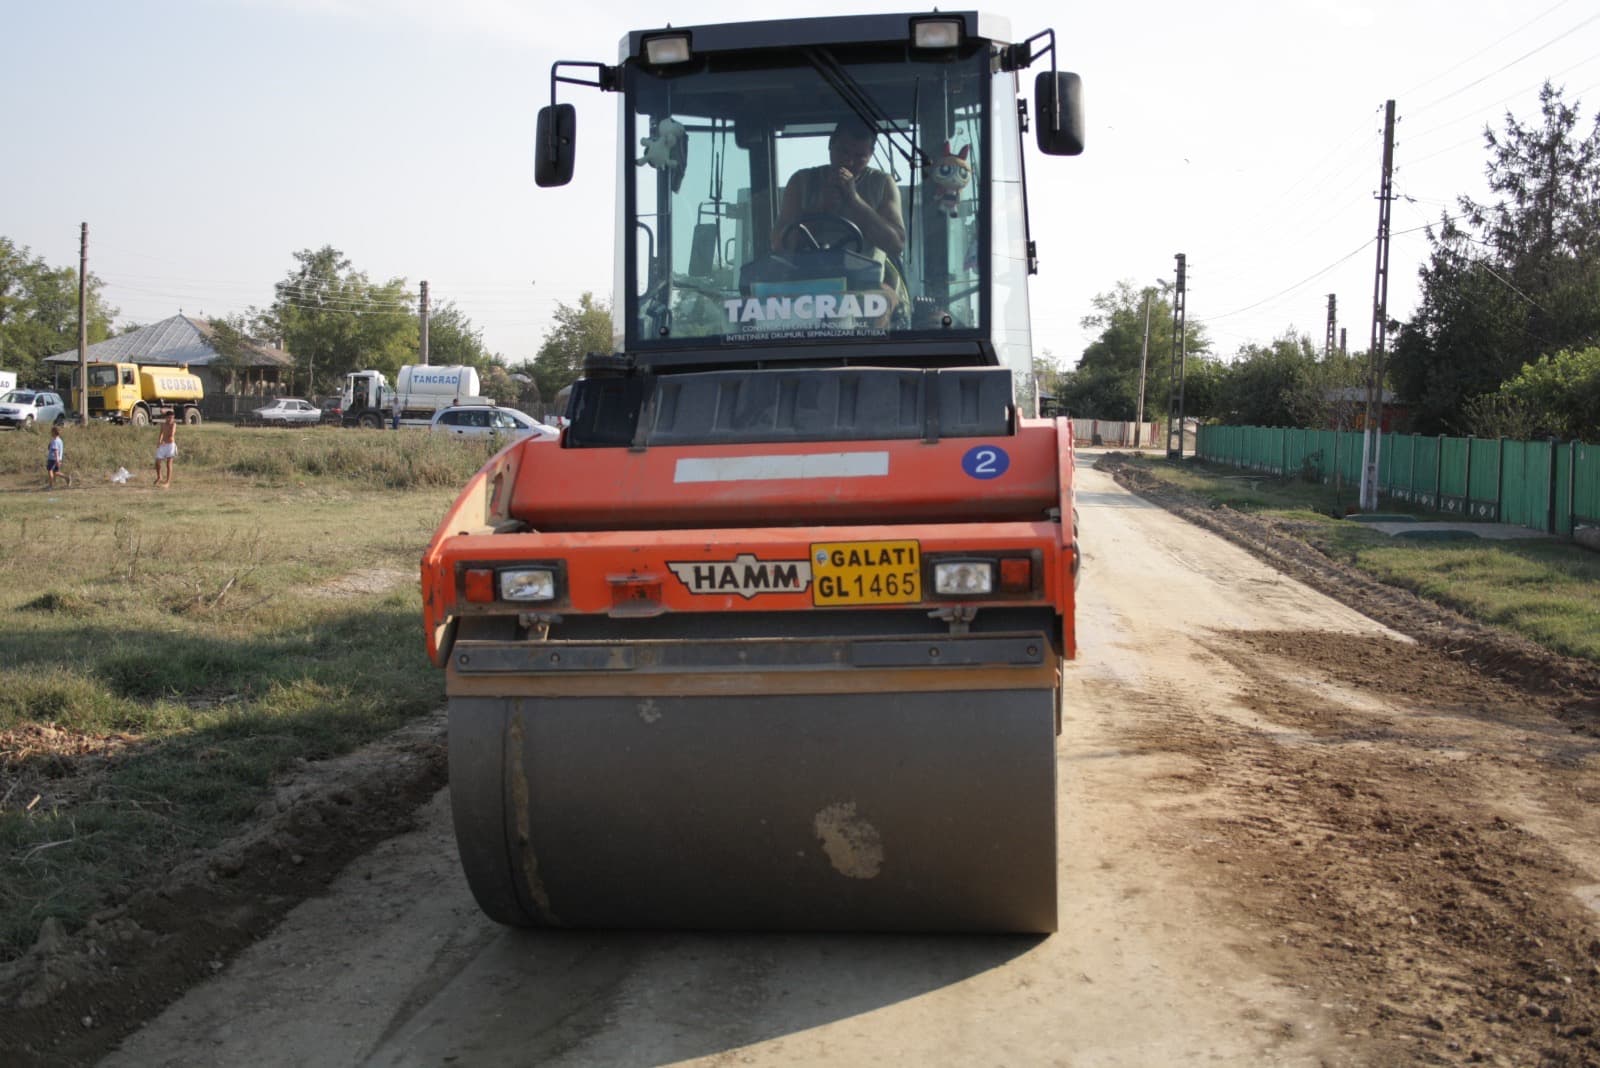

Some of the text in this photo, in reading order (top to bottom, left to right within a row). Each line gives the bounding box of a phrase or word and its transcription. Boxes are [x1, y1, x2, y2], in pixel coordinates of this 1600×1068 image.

[724, 294, 888, 323] TANCRAD
[161, 378, 198, 391] ECOSAL
[413, 374, 458, 385] TANCRAD
[975, 450, 997, 473] 2
[831, 548, 916, 568] GALATI
[693, 564, 801, 591] HAMM
